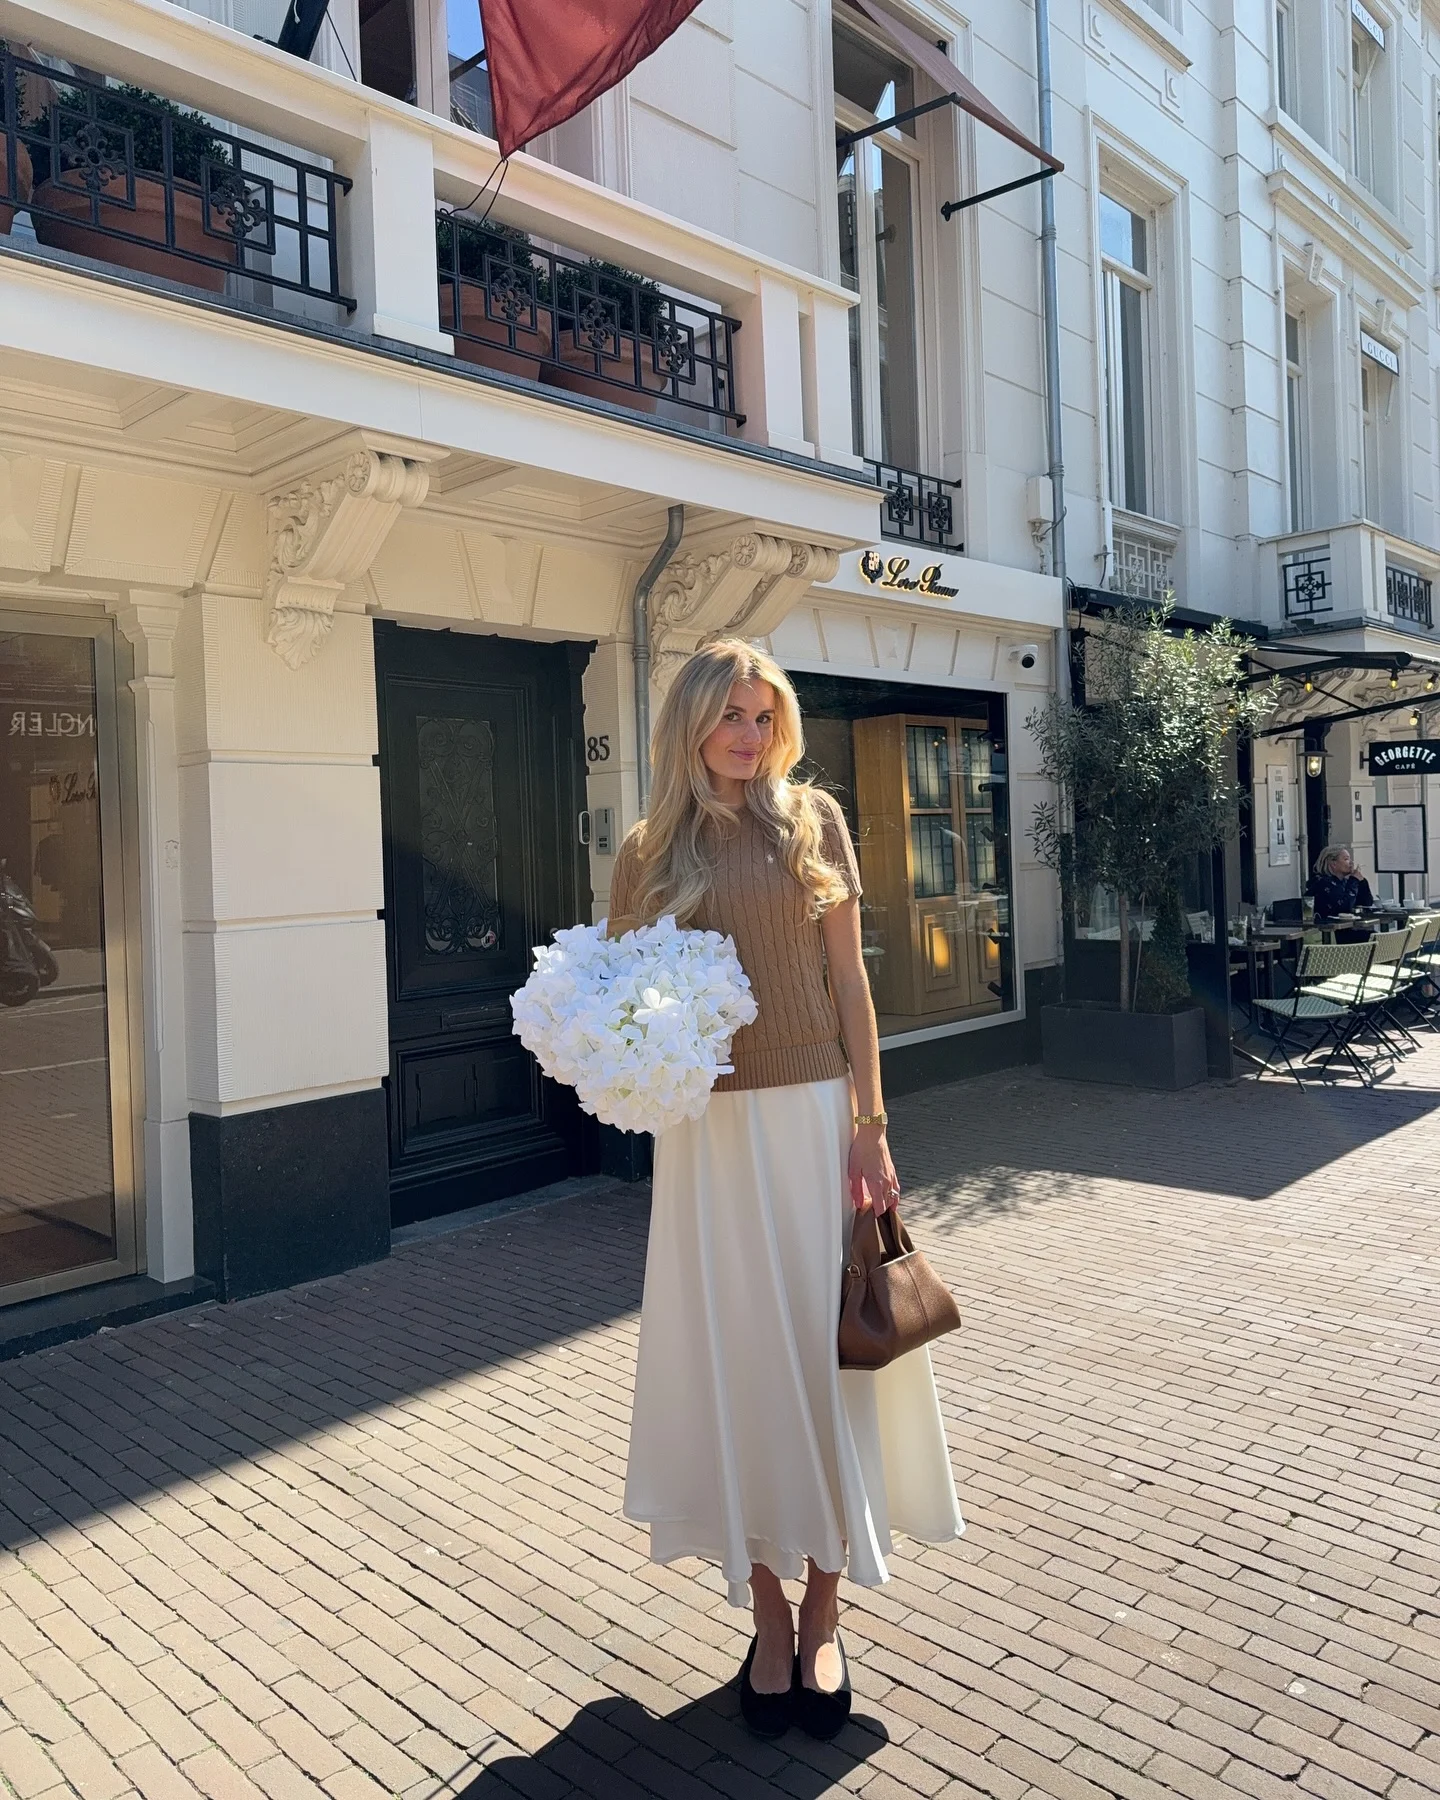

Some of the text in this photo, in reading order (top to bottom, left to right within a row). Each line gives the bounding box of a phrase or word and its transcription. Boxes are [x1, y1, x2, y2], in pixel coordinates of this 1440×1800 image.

[1355, 4, 1381, 41] GUCCI
[1367, 342, 1393, 368] GUCCI
[587, 735, 610, 761] 85
[1374, 746, 1436, 766] GEORGETTE
